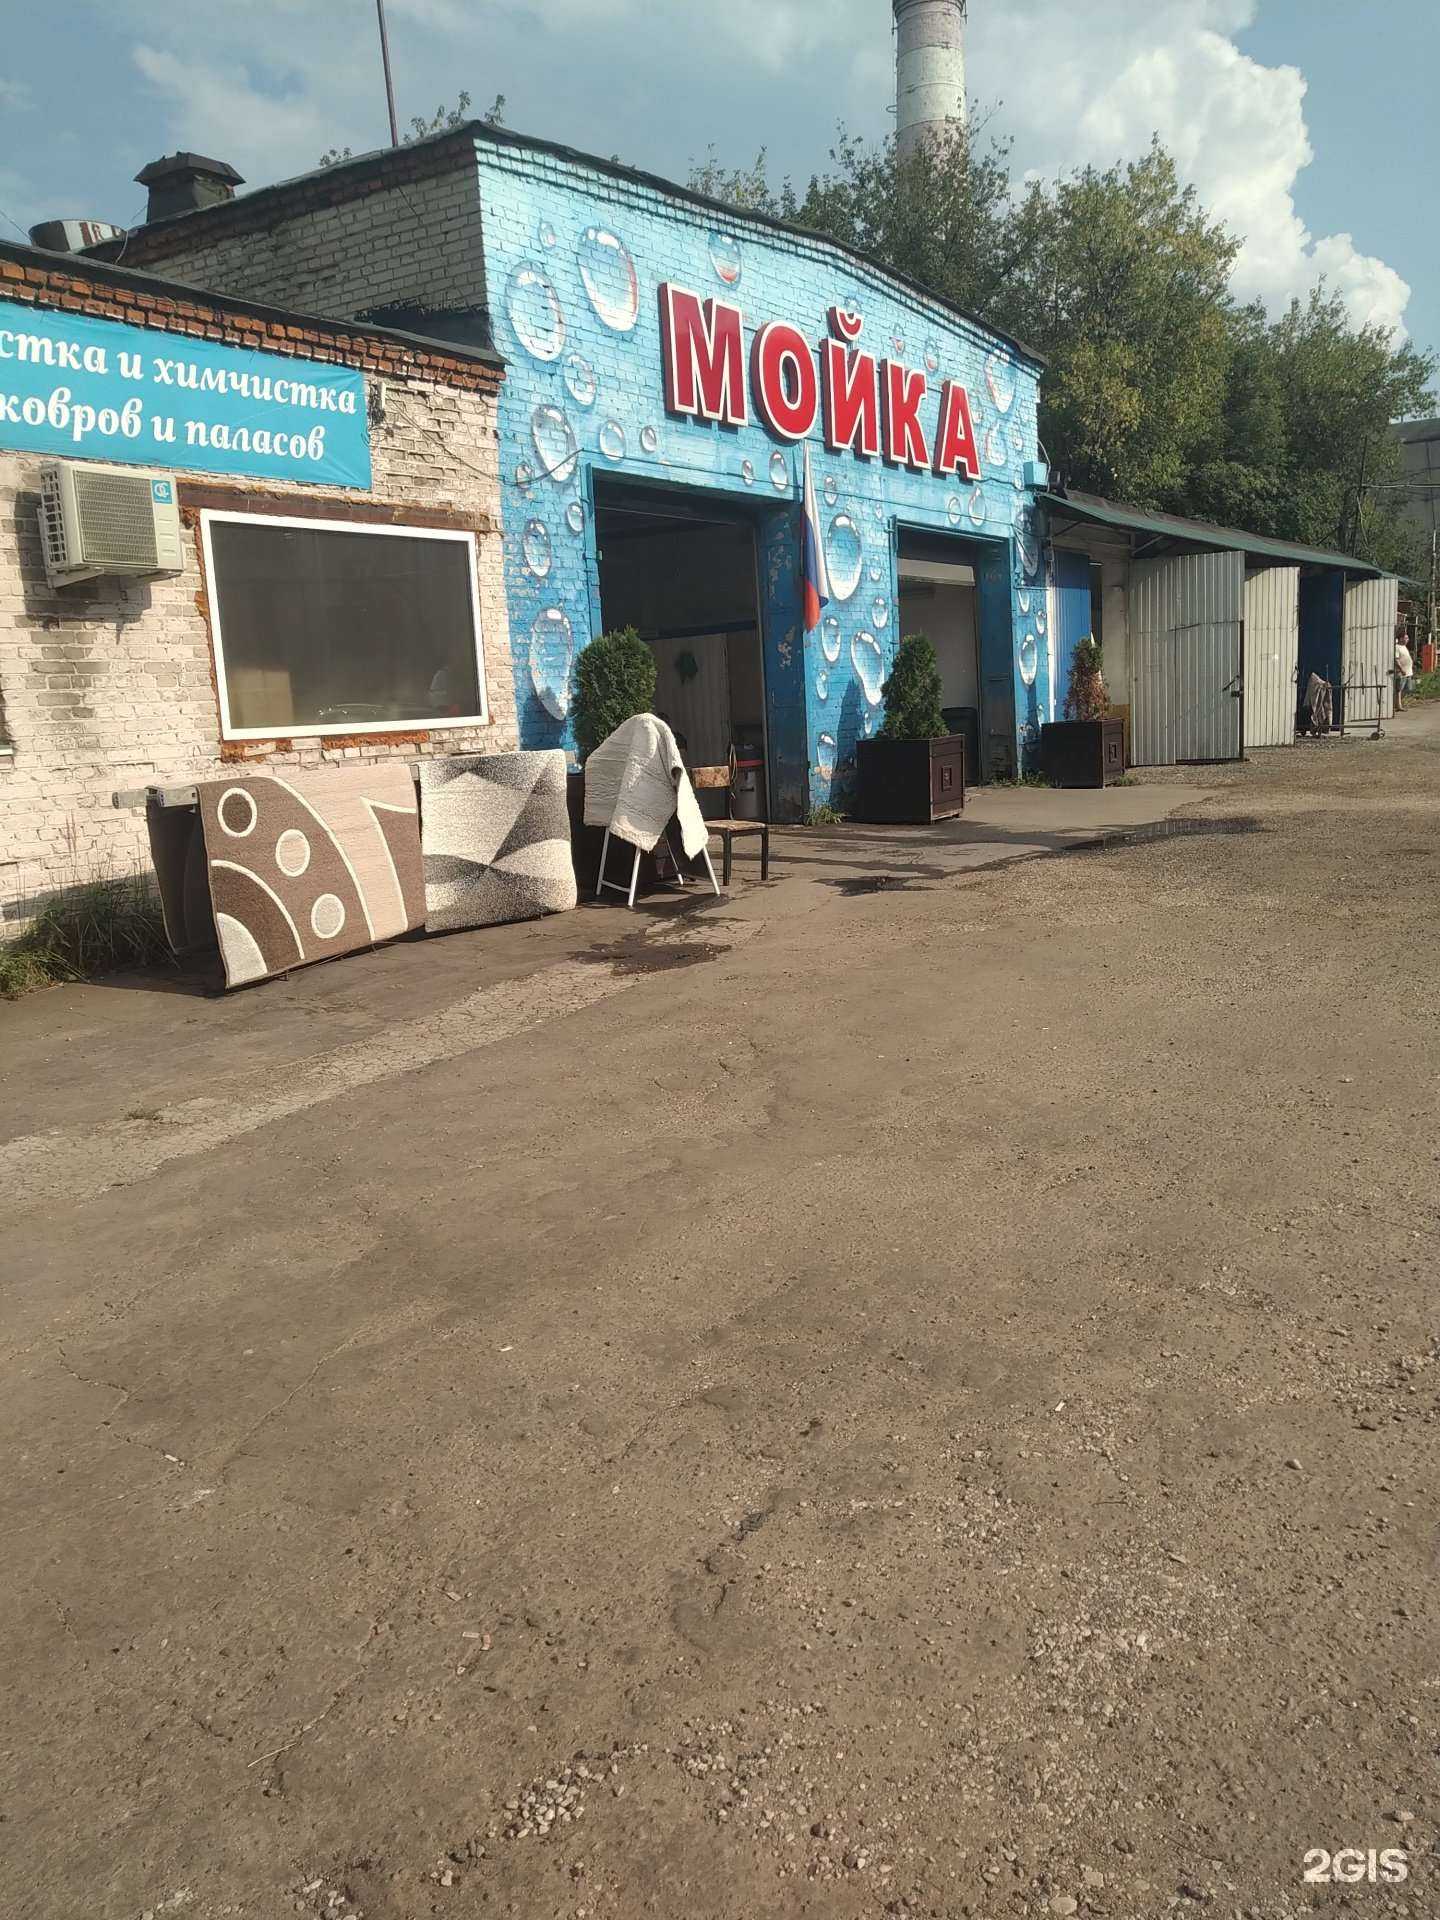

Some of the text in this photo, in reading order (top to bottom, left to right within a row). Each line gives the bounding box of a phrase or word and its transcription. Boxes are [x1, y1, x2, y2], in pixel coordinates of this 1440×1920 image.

[117, 351, 144, 380] и
[153, 357, 357, 415] химчистка
[658, 281, 983, 481] МОЙКА
[0, 386, 326, 461] ковров и паласов
